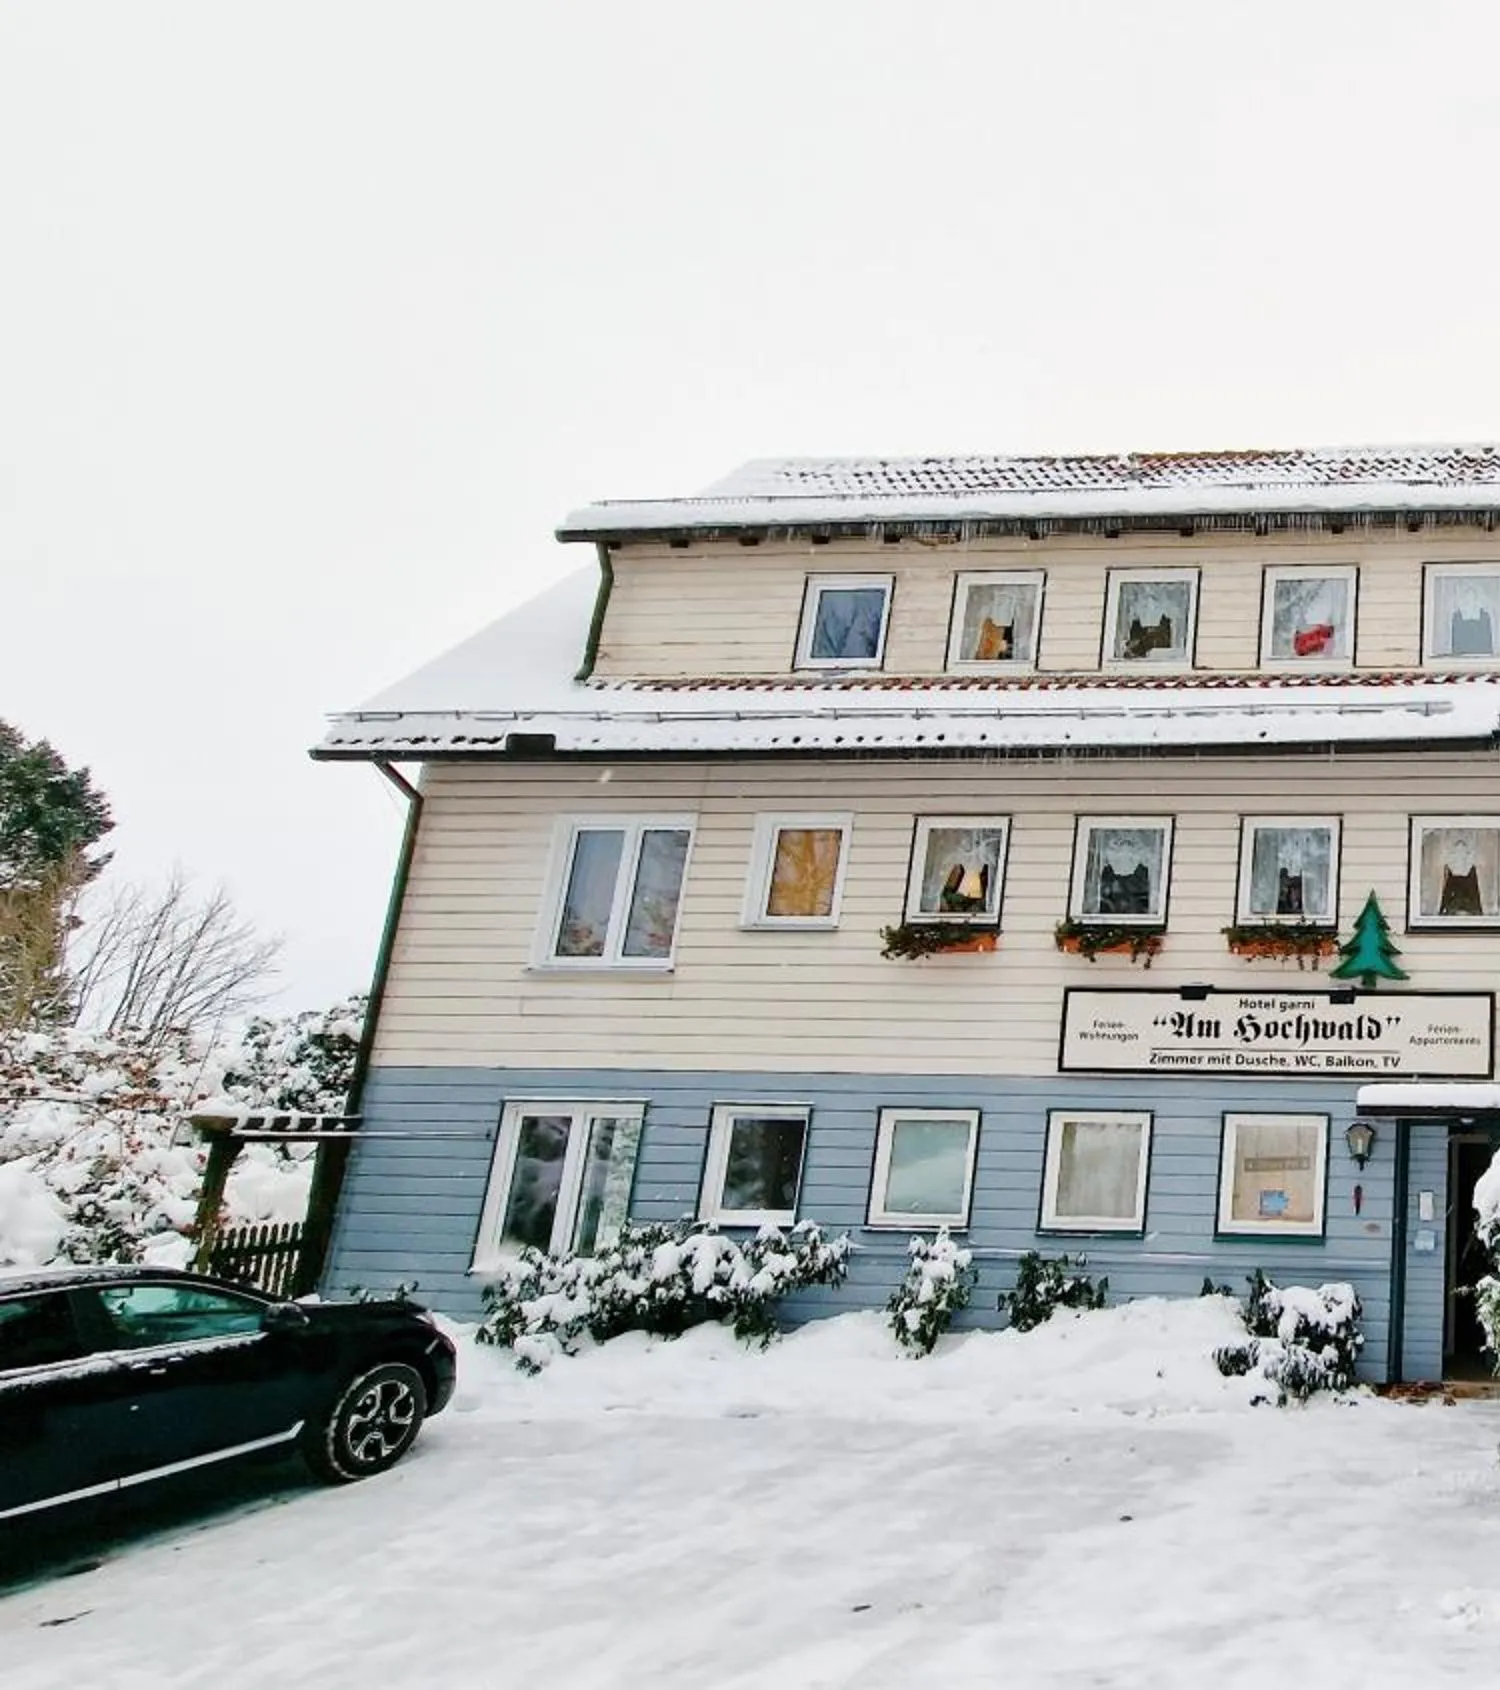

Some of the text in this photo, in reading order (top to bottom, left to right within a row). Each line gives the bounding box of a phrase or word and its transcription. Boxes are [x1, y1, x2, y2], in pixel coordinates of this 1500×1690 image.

[1239, 998, 1315, 1012] Hotel garni
[1149, 1053, 1204, 1065] Zimmer
[1207, 1054, 1231, 1065] mit
[1325, 1055, 1379, 1068] Balkon,
[1382, 1056, 1401, 1068] TV
